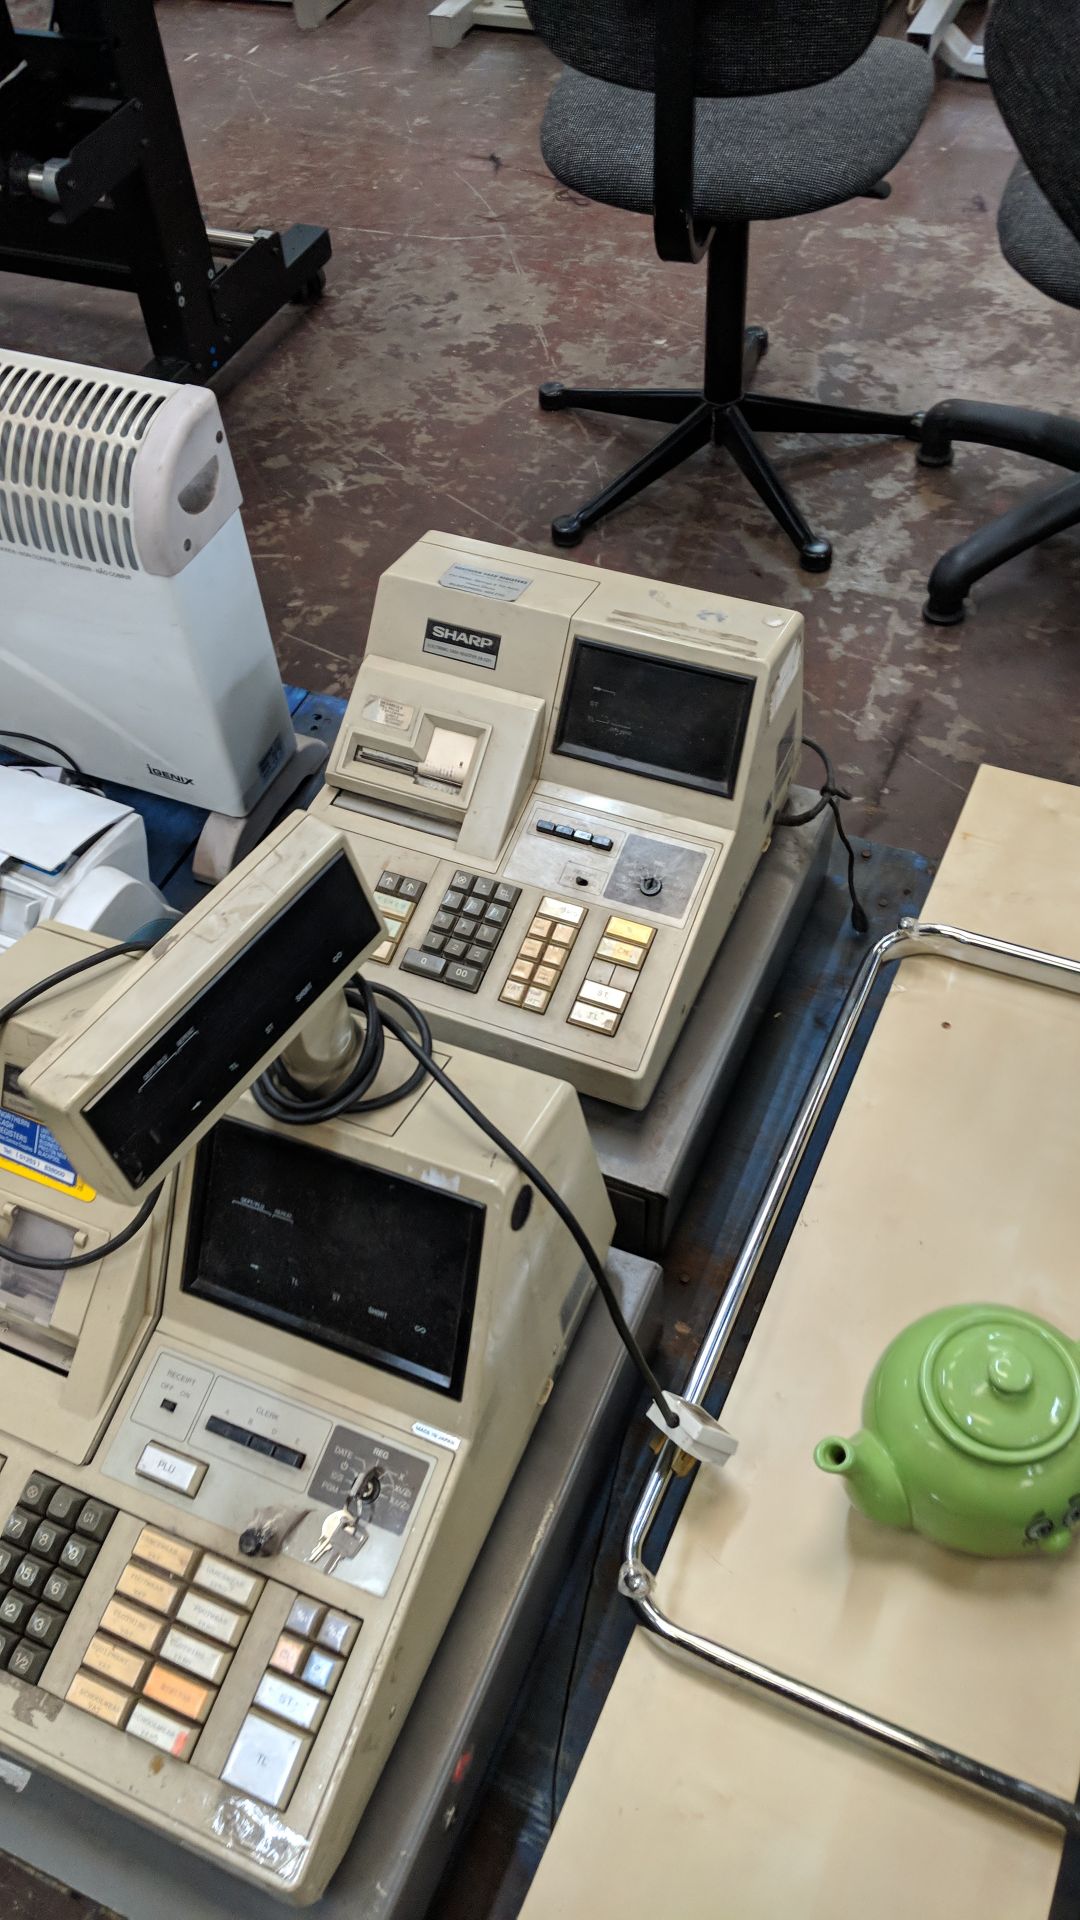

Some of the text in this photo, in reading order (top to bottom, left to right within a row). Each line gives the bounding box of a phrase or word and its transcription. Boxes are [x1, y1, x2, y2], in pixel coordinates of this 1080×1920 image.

[432, 625, 493, 648] SHARP
[455, 968, 468, 978] 00
[0, 1127, 28, 1144] EGISTERS
[167, 1369, 196, 1386] RECEIPT
[160, 1382, 191, 1399] OFF ON
[256, 1406, 279, 1420] CLERK
[415, 1425, 430, 1436] MADE
[438, 1434, 455, 1446] JAPAN
[334, 1445, 354, 1460] DATE
[373, 1446, 390, 1460] REG
[157, 1458, 176, 1475] PLU
[321, 1481, 339, 1493] PGM
[39, 1533, 49, 1546] 8
[51, 1582, 61, 1595] 6
[5, 1603, 16, 1617] 2
[34, 1618, 44, 1631] 3
[256, 1753, 268, 1767] TL
